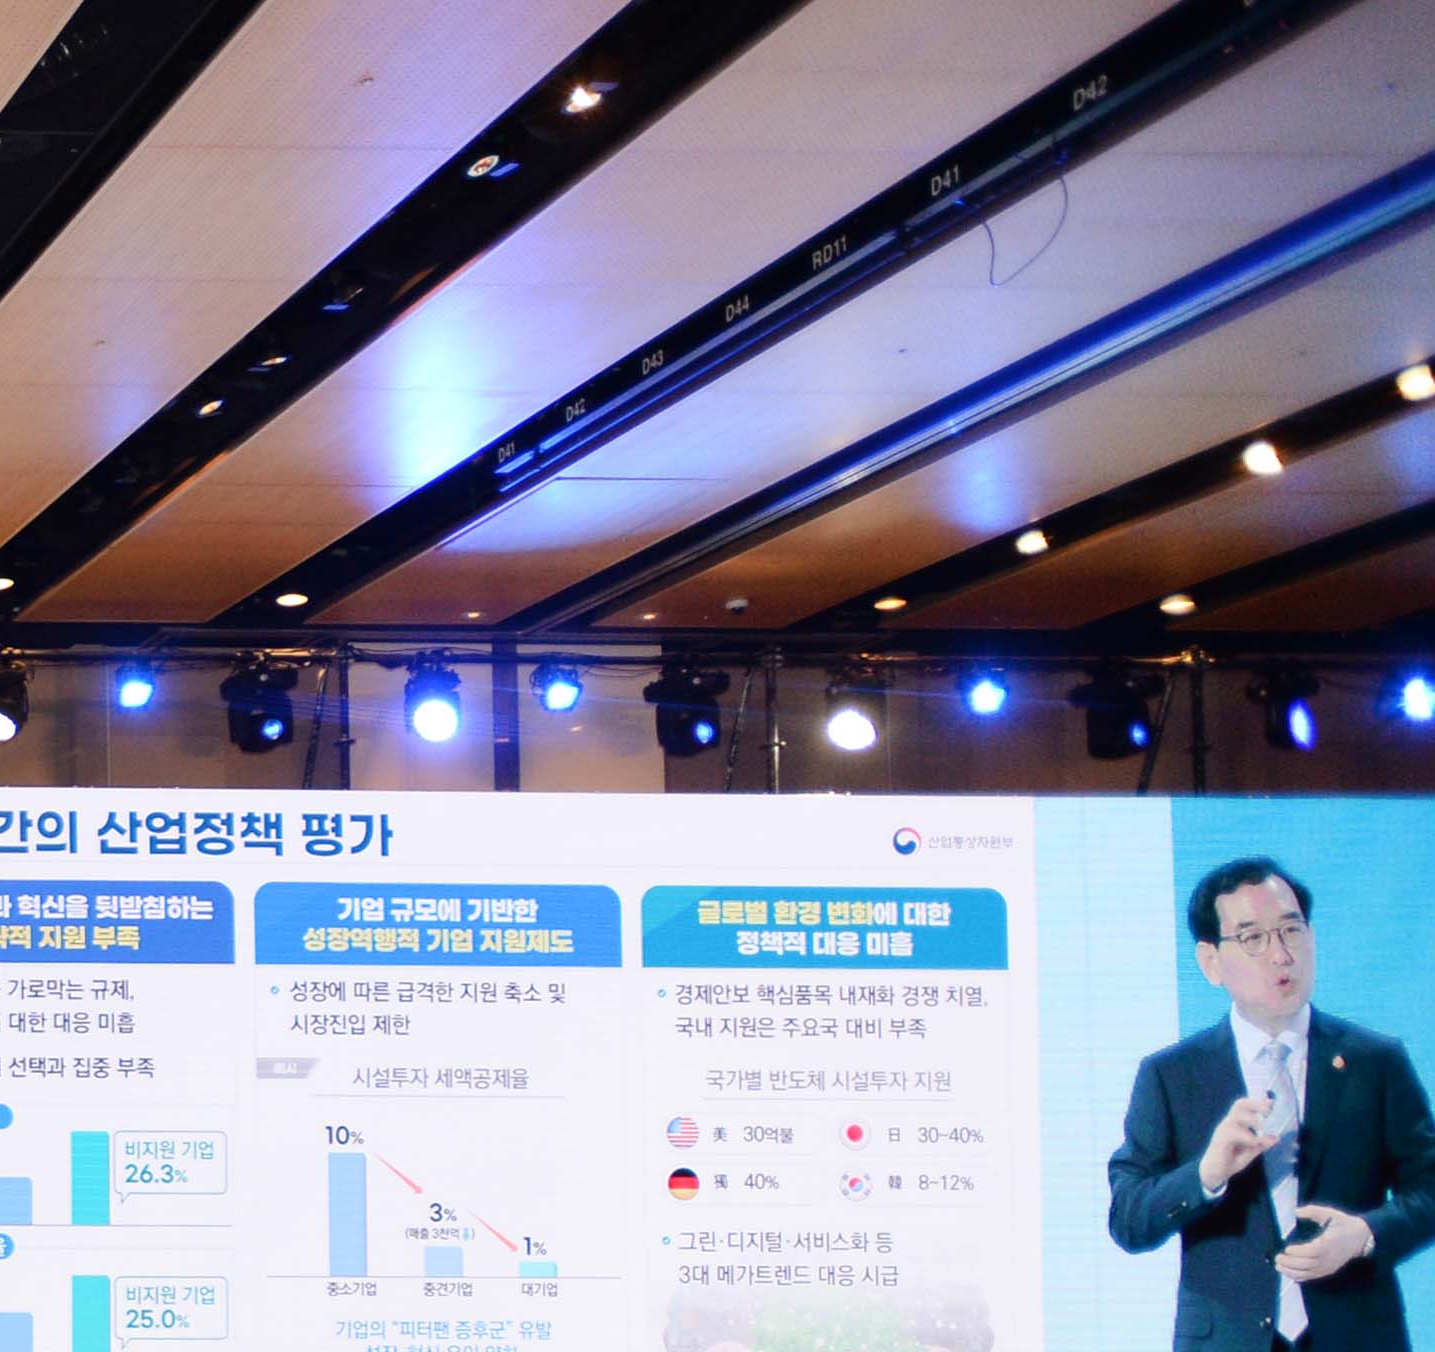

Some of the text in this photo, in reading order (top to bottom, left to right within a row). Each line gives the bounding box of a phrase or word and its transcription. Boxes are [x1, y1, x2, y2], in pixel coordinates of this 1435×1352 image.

[1071, 74, 1108, 111] D42
[931, 165, 961, 196] D41
[812, 235, 849, 271] RD11
[725, 295, 750, 323] D44
[642, 348, 664, 376] D43
[566, 398, 586, 424] D42
[498, 440, 516, 464] D41
[97, 810, 284, 857] 산업정책
[301, 812, 394, 858] 평가
[16, 893, 90, 920] 혁신을
[94, 894, 215, 921] 뒷받침하는
[696, 899, 953, 928] 글로벌 환경 변화에 대한
